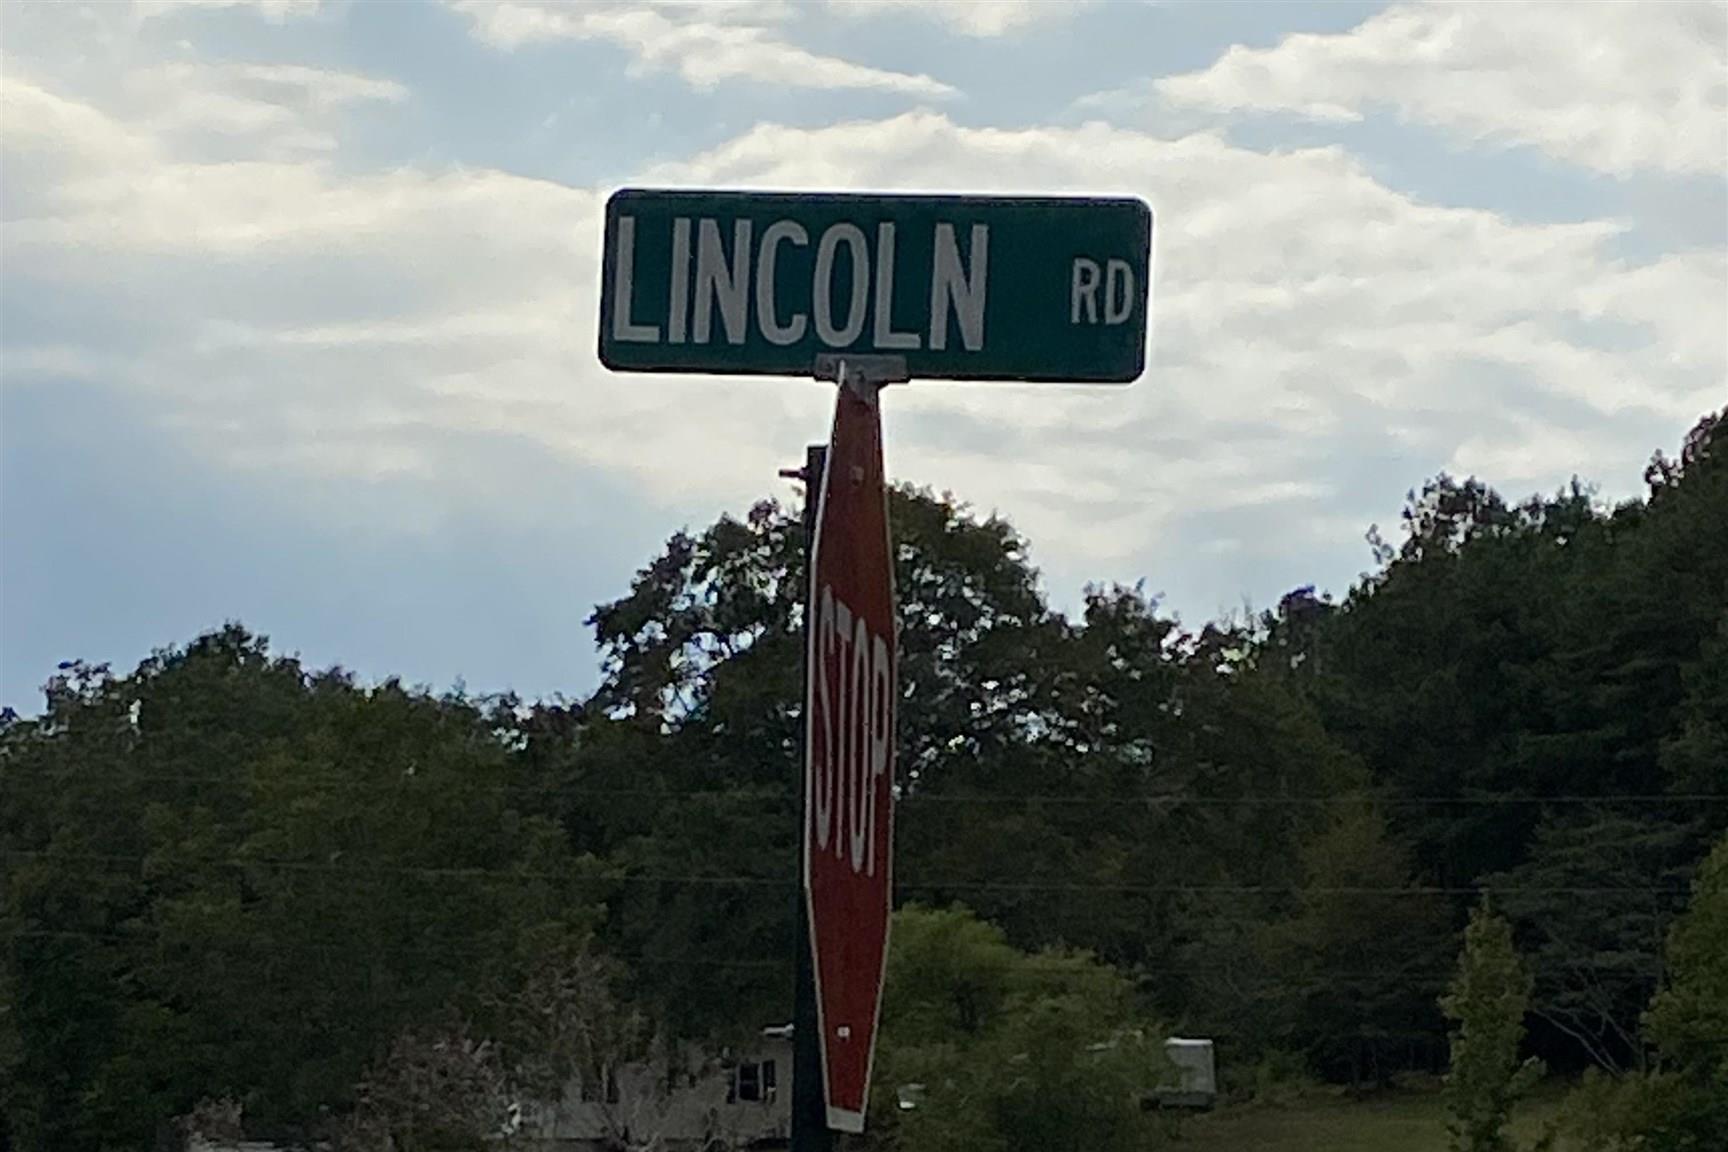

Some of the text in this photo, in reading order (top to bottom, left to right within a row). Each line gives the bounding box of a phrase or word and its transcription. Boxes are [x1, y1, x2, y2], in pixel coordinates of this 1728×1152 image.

[613, 216, 1134, 351] LINCOLN RD
[816, 584, 889, 877] STOP
